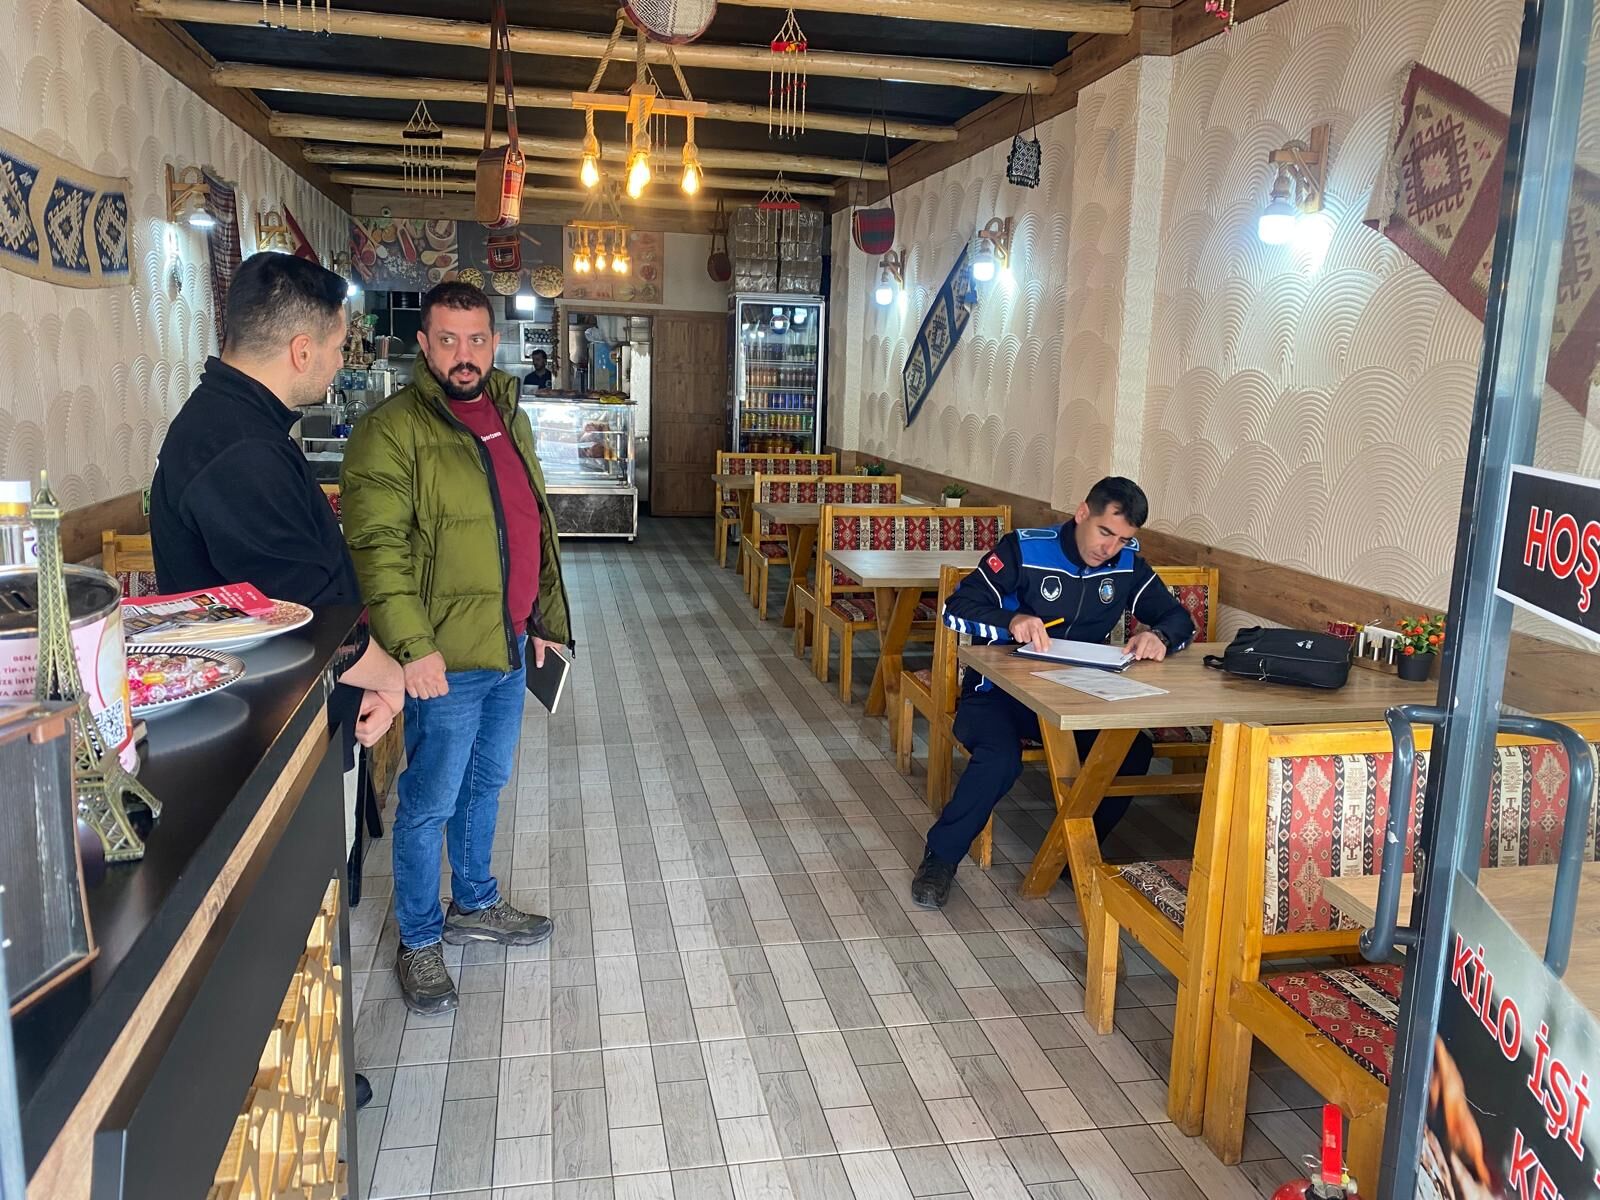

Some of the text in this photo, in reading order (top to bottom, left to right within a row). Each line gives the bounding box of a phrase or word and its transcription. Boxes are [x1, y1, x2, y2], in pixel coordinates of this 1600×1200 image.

[1523, 505, 1600, 613] HOŞ
[1451, 932, 1591, 1162] KİLO İŞİ
